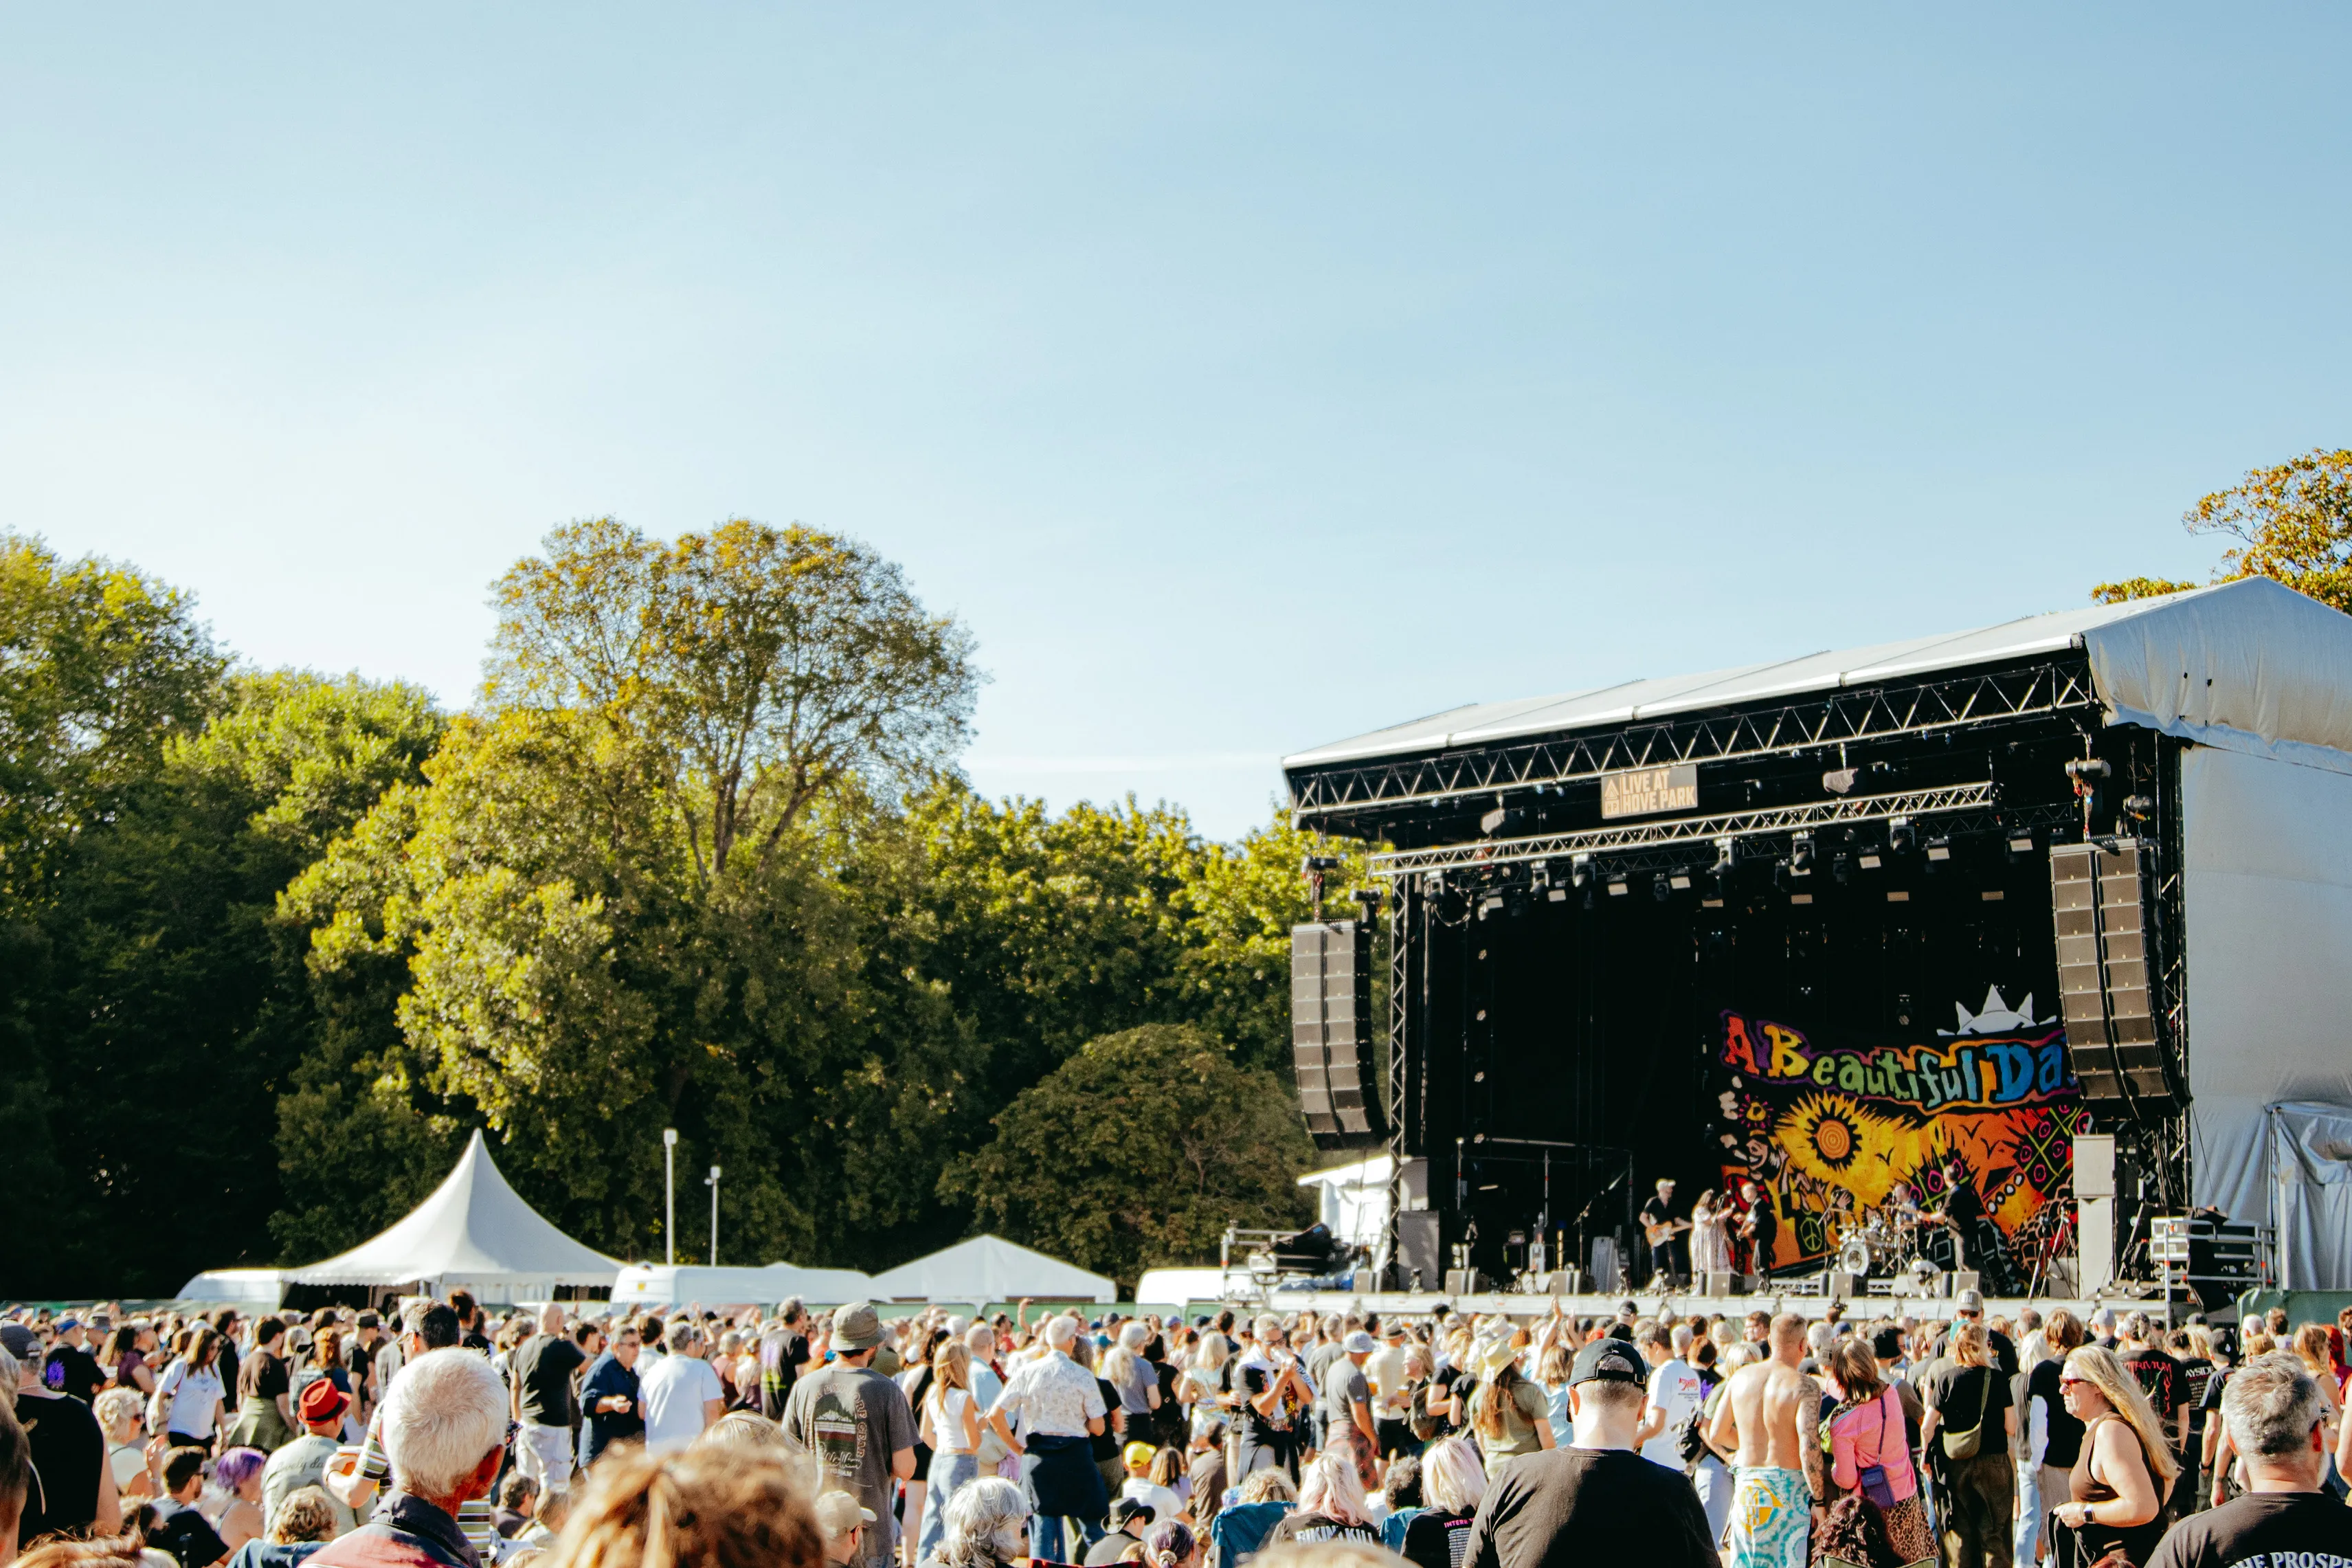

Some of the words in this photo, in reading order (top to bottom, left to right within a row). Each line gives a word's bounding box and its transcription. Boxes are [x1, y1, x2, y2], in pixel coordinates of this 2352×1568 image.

[1622, 774, 1650, 794] LIVE
[1653, 769, 1670, 790] AT
[1622, 791, 1657, 814] HOVE
[1659, 785, 1696, 809] PARK
[1725, 1016, 1760, 1075] A
[1764, 1024, 1977, 1108] Beautiful
[1985, 1035, 2078, 1101] Da
[2185, 1366, 2213, 1378] AYSID
[855, 1422, 867, 1457] GEAR
[309, 1457, 324, 1469] da
[1444, 1518, 1475, 1528] INTERR
[1344, 1527, 1377, 1548] KILL
[2228, 1554, 2265, 1568] HE
